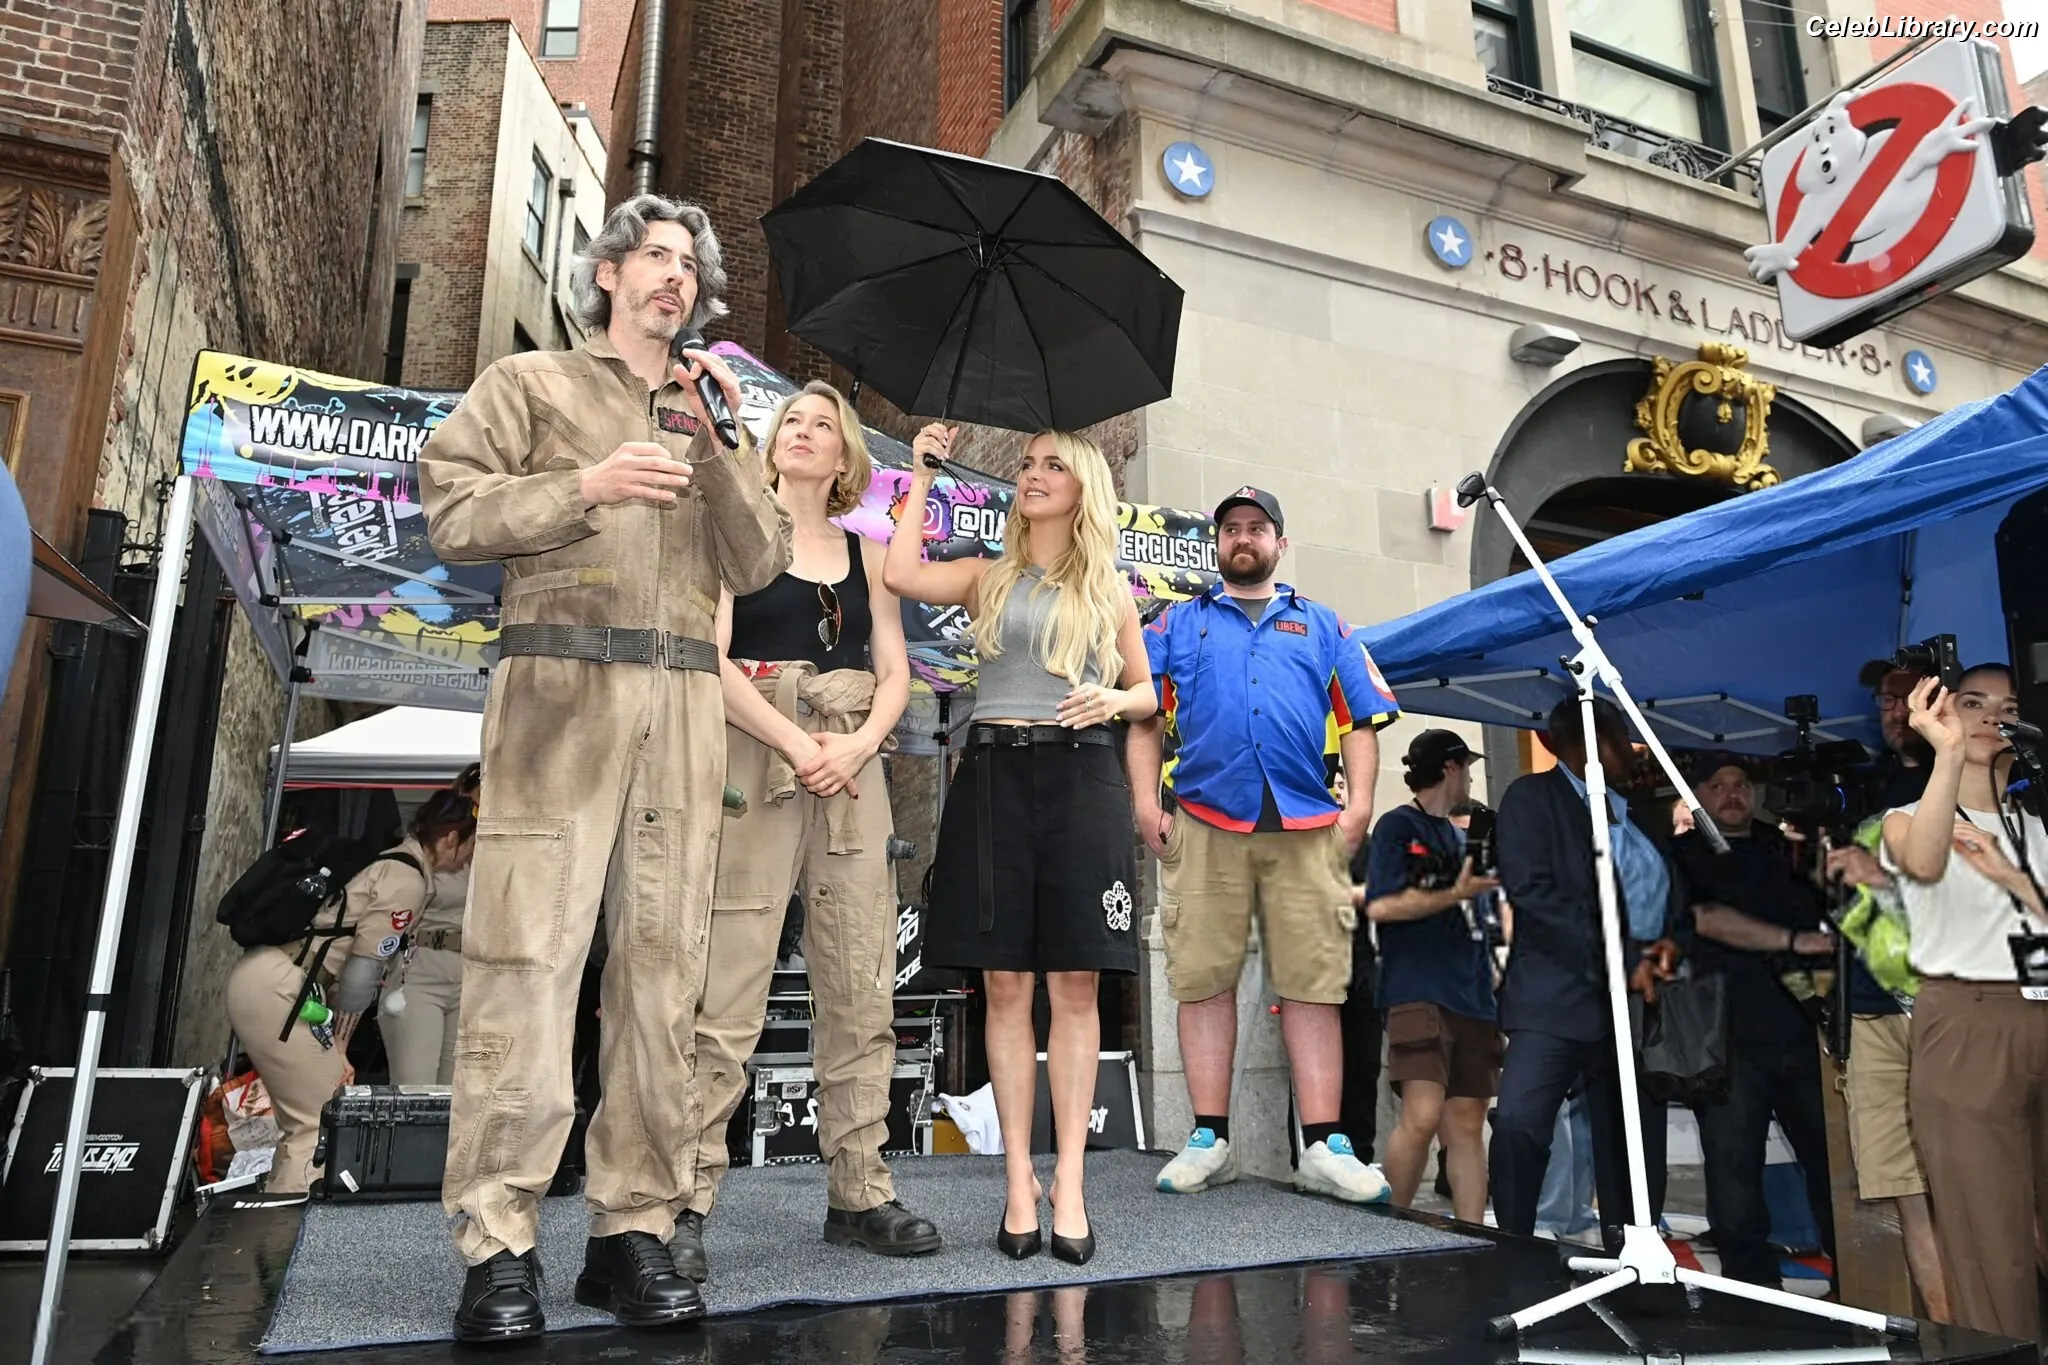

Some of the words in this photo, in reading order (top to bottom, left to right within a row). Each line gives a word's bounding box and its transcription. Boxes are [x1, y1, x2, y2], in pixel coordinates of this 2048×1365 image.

[1542, 253, 1662, 317] HOOK
[1669, 289, 1697, 327] &
[251, 403, 434, 463] WWW.DARK
